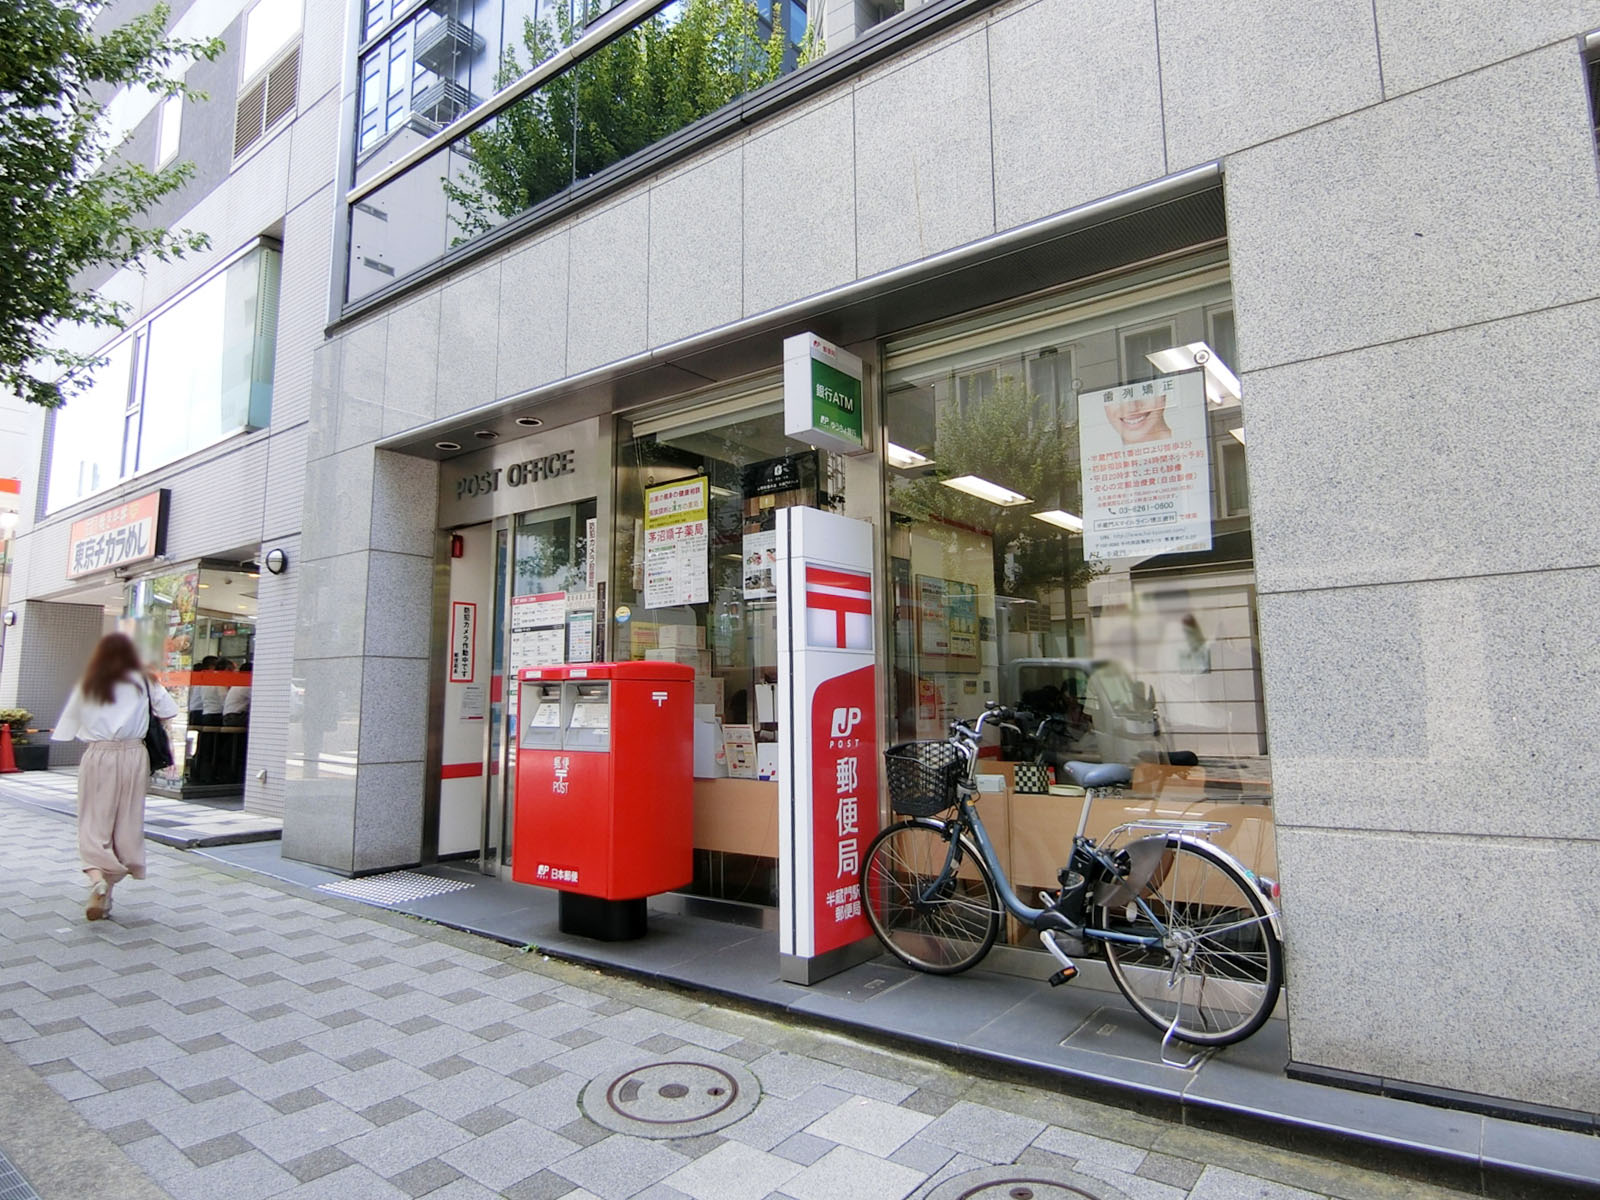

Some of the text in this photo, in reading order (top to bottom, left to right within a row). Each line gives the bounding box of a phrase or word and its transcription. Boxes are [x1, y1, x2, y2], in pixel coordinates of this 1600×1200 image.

[816, 384, 854, 411] 銀行ATM
[1103, 380, 1174, 402] 歯列矯正
[830, 421, 857, 437] ゆうちょ銀行
[456, 449, 575, 500] POST OFFICE
[648, 523, 704, 543] 茅沼順子薬局
[73, 521, 148, 573] 東京チカラめし
[461, 606, 471, 678] 防犯カメラ作動中です
[831, 707, 861, 738] JP
[829, 738, 860, 749] POST
[553, 756, 570, 770] 郵便
[552, 781, 569, 794] POST
[835, 756, 859, 880] 郵便局
[551, 868, 579, 883] 日本郵便
[835, 900, 861, 922] 郵便局
